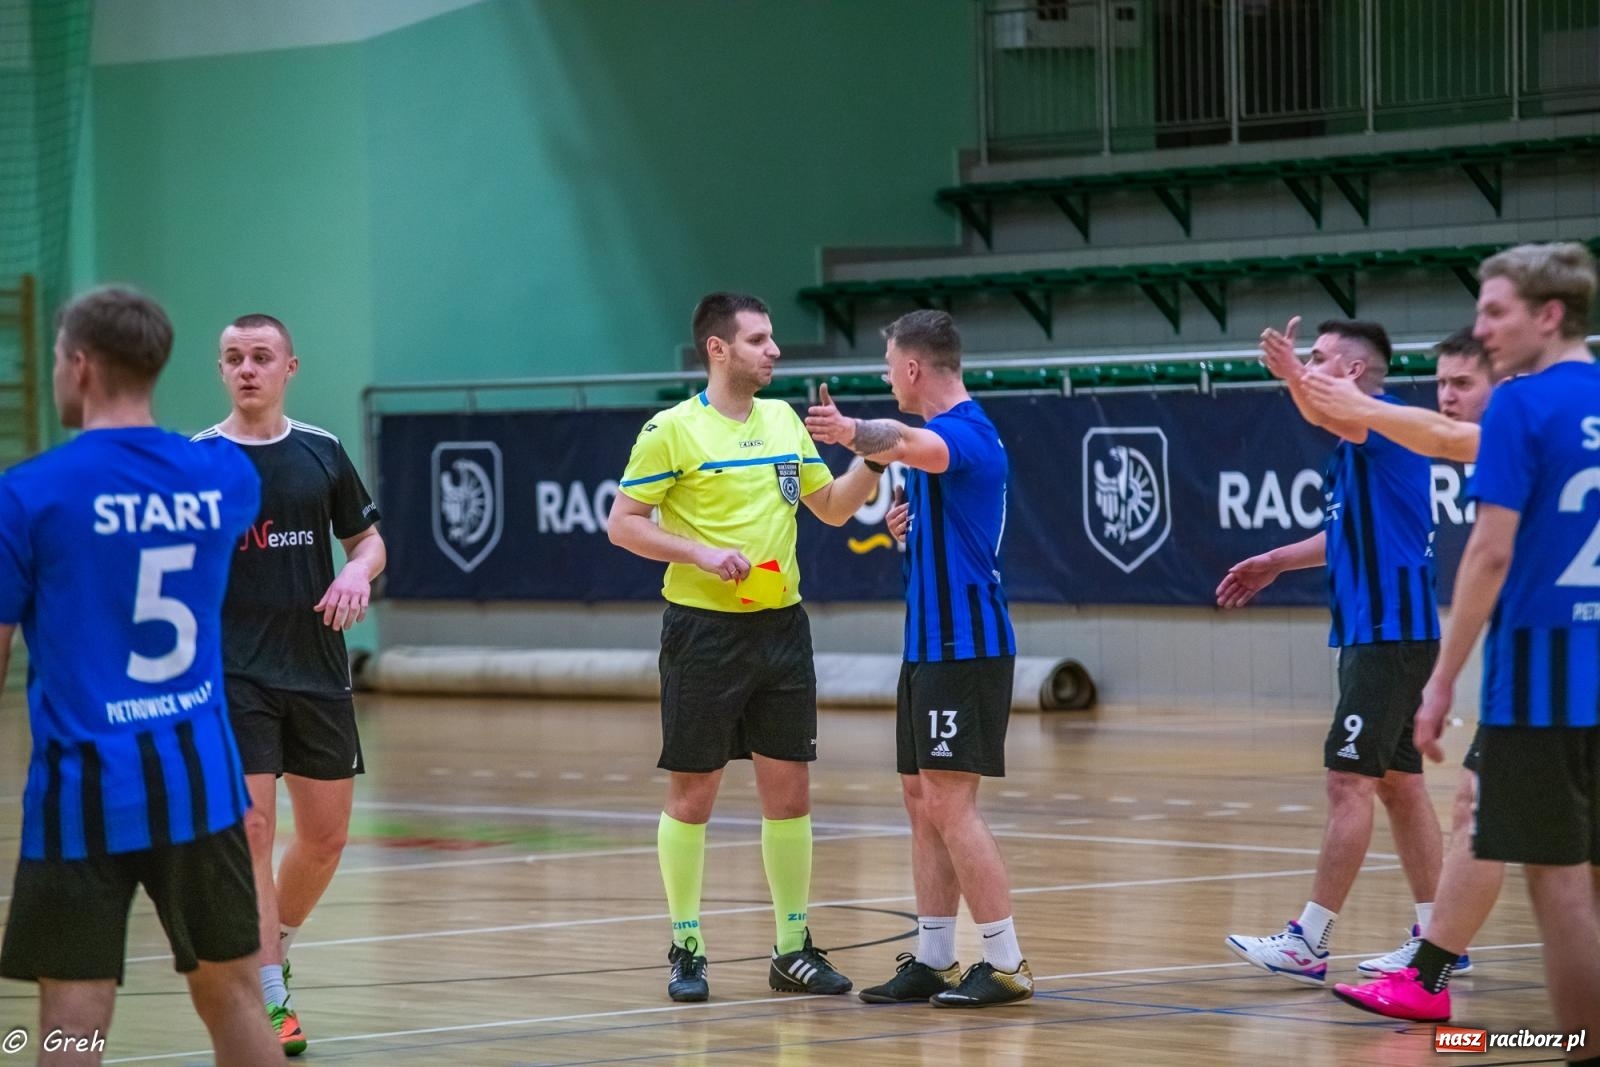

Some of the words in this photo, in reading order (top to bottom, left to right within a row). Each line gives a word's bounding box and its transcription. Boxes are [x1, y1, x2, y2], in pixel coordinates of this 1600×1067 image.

[93, 490, 222, 535] START
[240, 519, 314, 551] Nexans
[126, 543, 198, 683] 5
[928, 710, 958, 739] 13
[1343, 714, 1364, 742] 9
